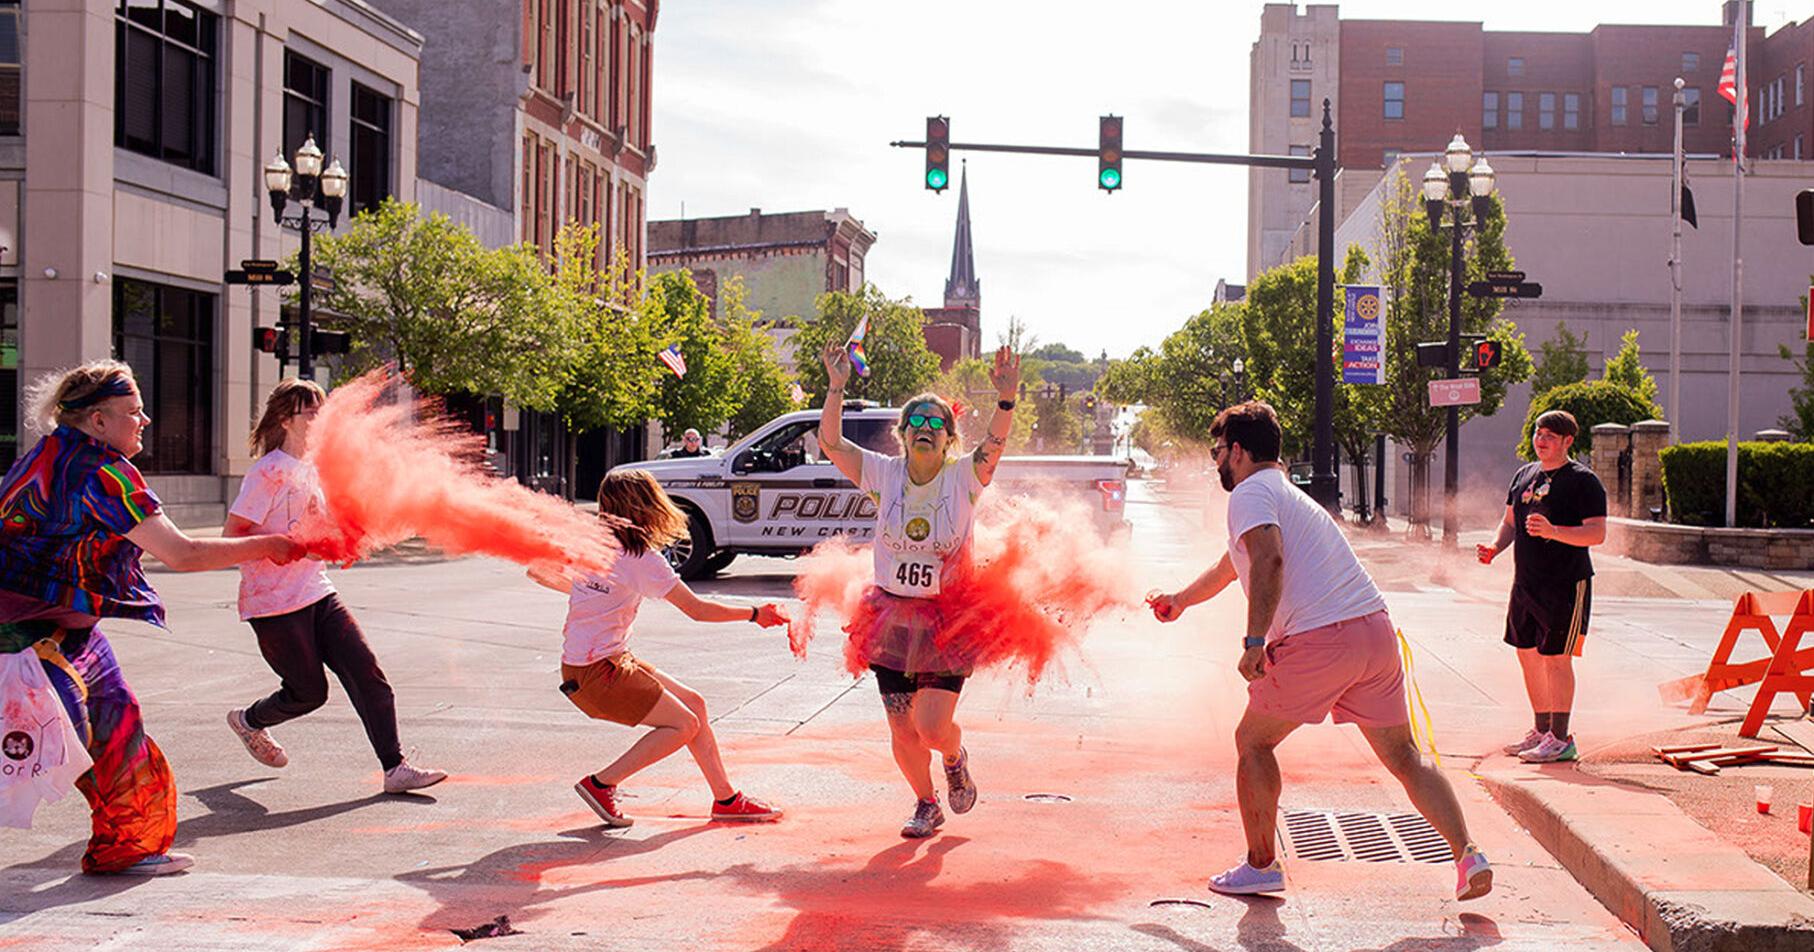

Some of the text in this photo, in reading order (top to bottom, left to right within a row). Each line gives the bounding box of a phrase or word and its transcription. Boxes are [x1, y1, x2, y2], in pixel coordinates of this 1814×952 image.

[768, 493, 878, 520] POLIC
[761, 526, 872, 537] NEW CAST
[882, 533, 960, 551] Color Run
[896, 562, 934, 588] 465
